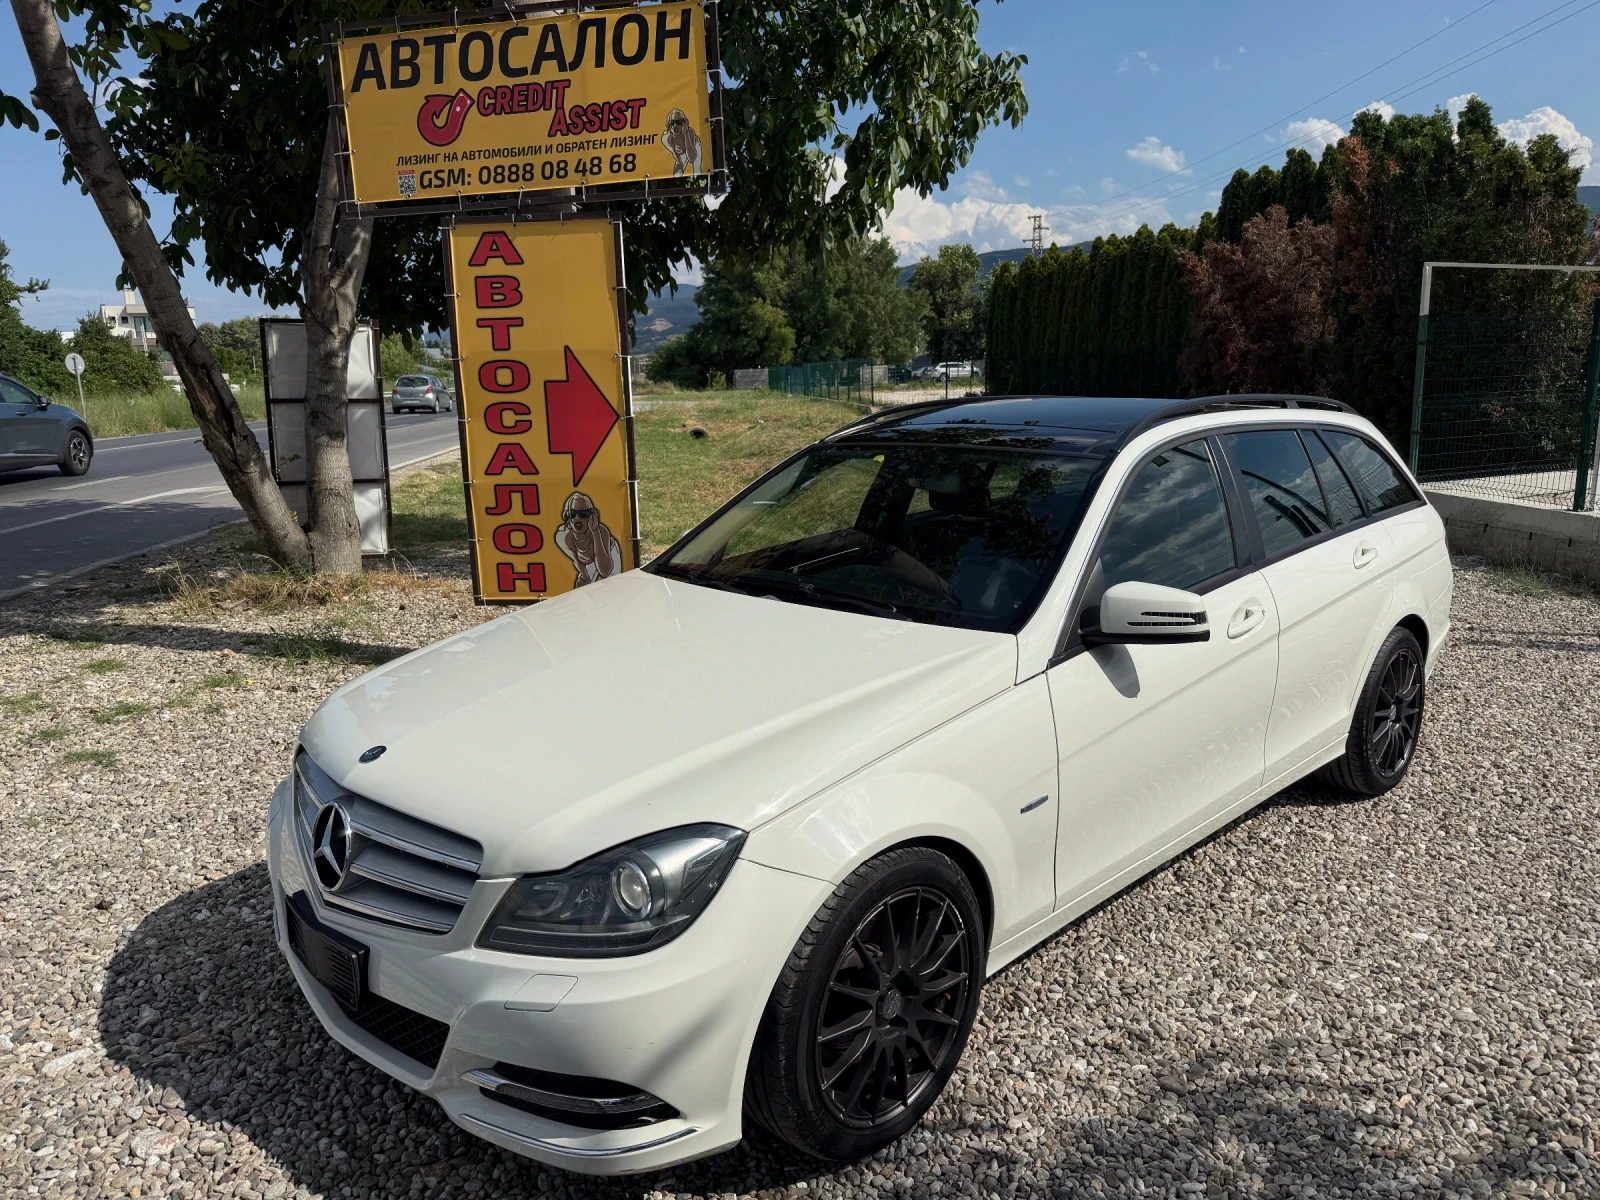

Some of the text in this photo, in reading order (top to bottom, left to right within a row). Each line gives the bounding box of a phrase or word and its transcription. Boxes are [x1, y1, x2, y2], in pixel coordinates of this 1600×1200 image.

[350, 8, 692, 93] АВТОСАЛОН
[476, 79, 571, 117] CREDIT
[548, 97, 647, 137] ASSIST
[396, 134, 659, 167] ЛИЗИНГ НА АВТОМОБИЛИ И ОБРАТЕН ЛИЗИНГ
[419, 153, 637, 190] GSM: 0888 08 48 68
[468, 231, 547, 593] АВТОСАЛОН
